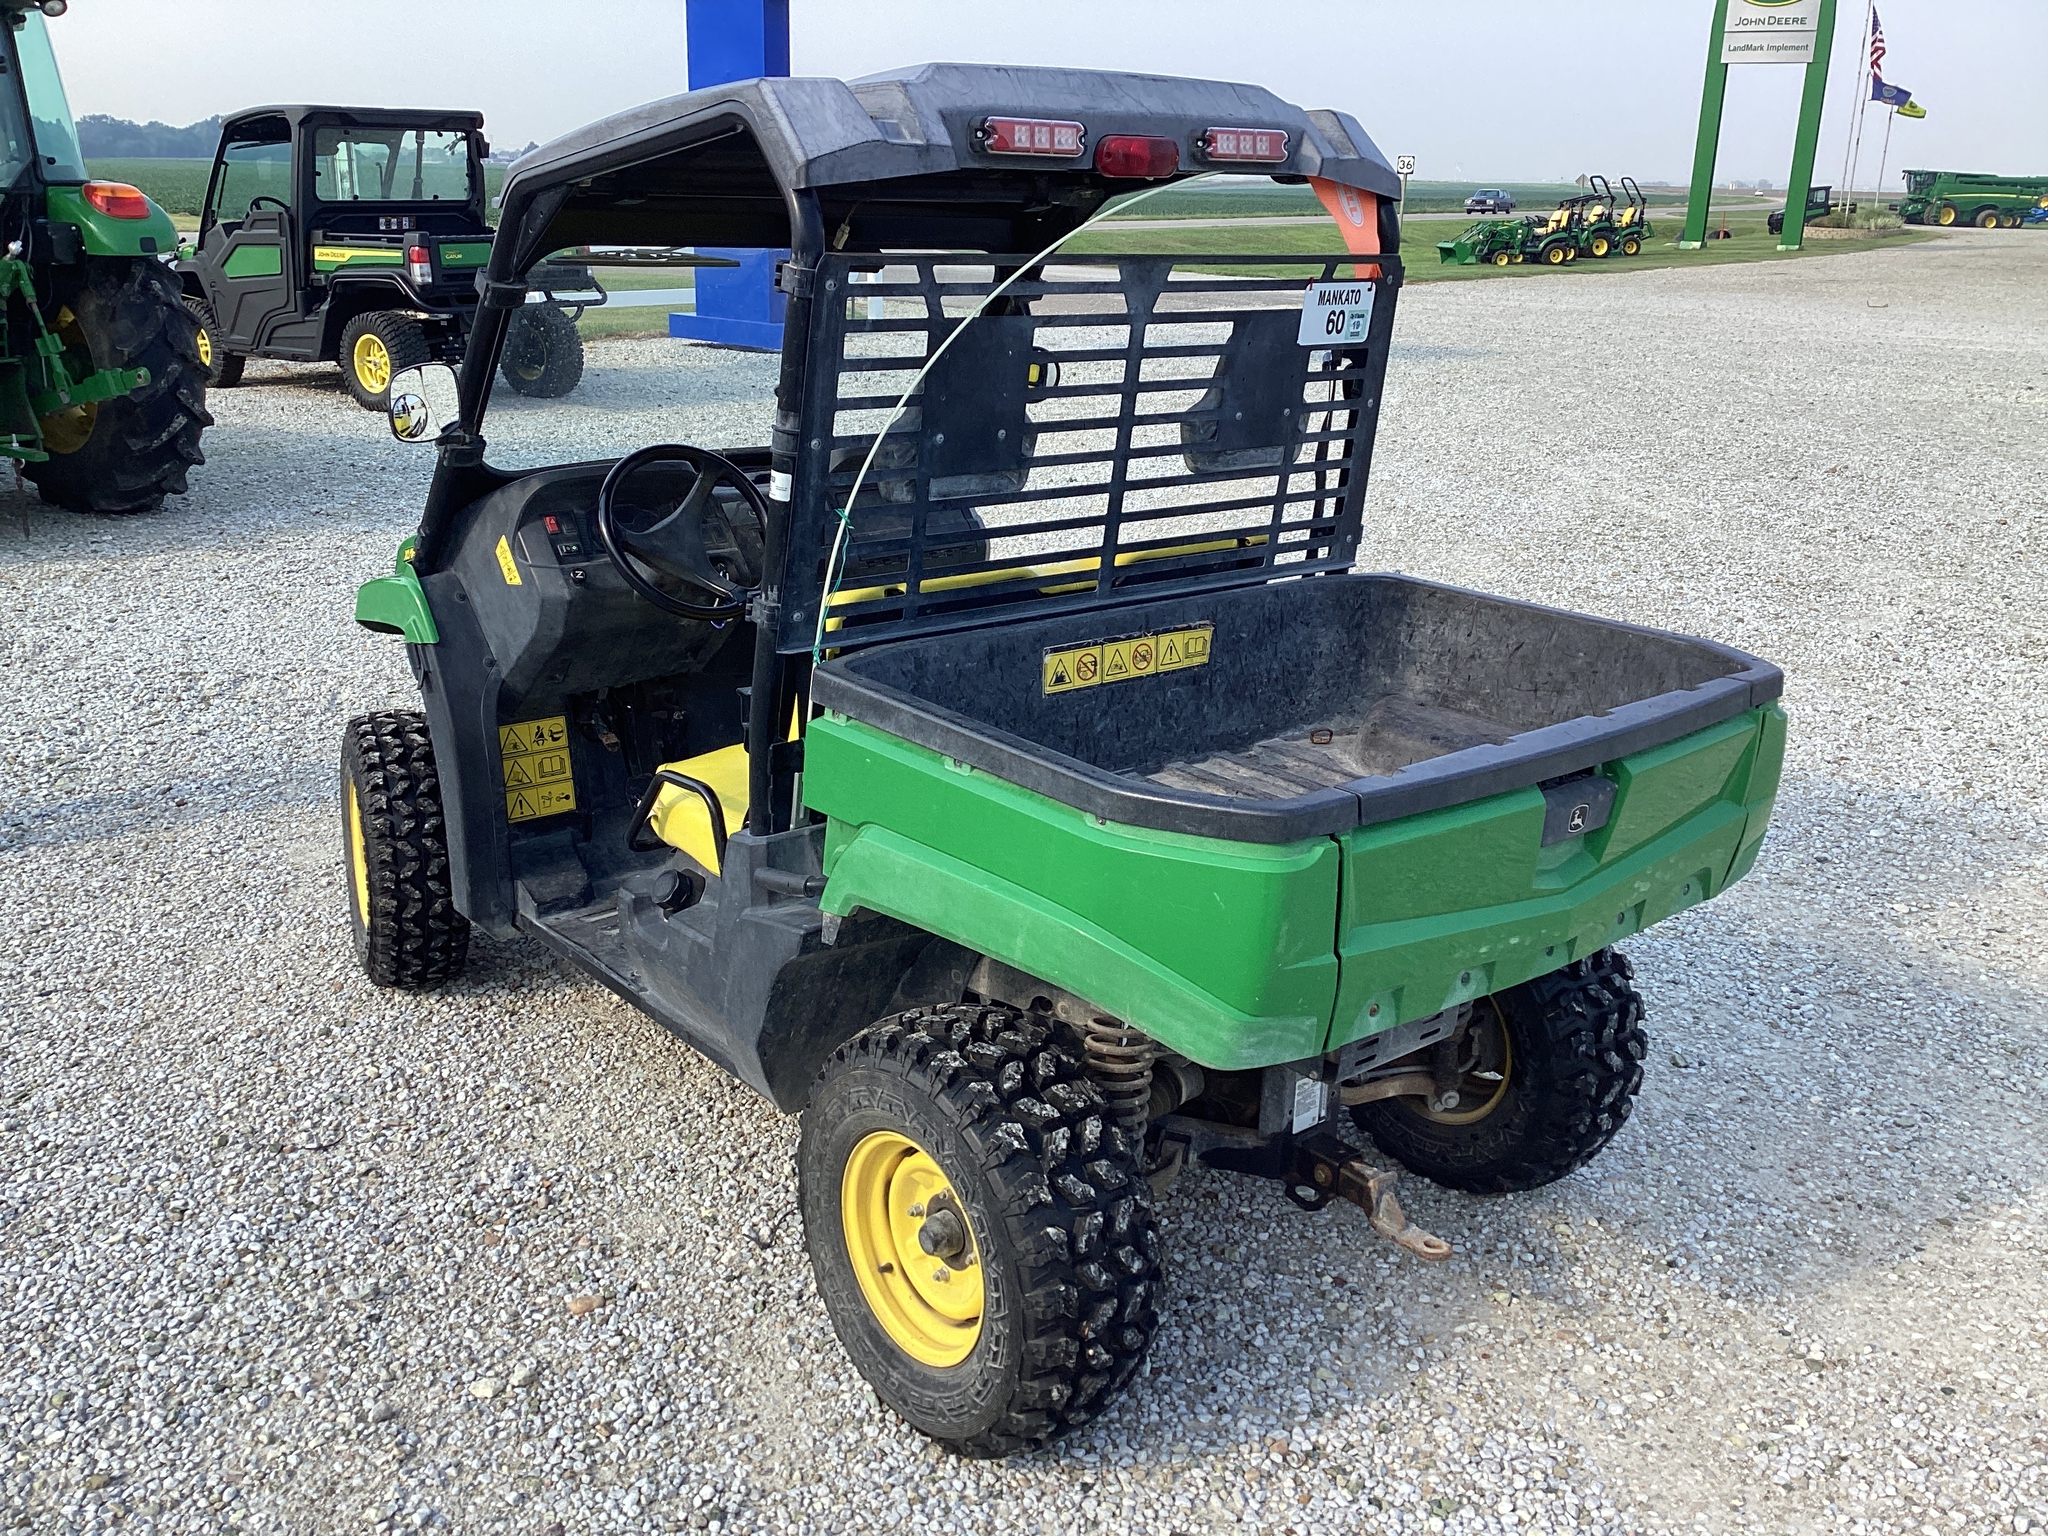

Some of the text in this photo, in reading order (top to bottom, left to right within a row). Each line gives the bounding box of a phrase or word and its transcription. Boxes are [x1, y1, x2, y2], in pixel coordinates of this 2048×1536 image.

[1734, 16, 1808, 27] JOHN DEERE
[1728, 43, 1809, 52] LandMark Implement
[1399, 159, 1413, 170] 36
[1317, 289, 1362, 306] MANKATO
[1325, 309, 1346, 335] 60
